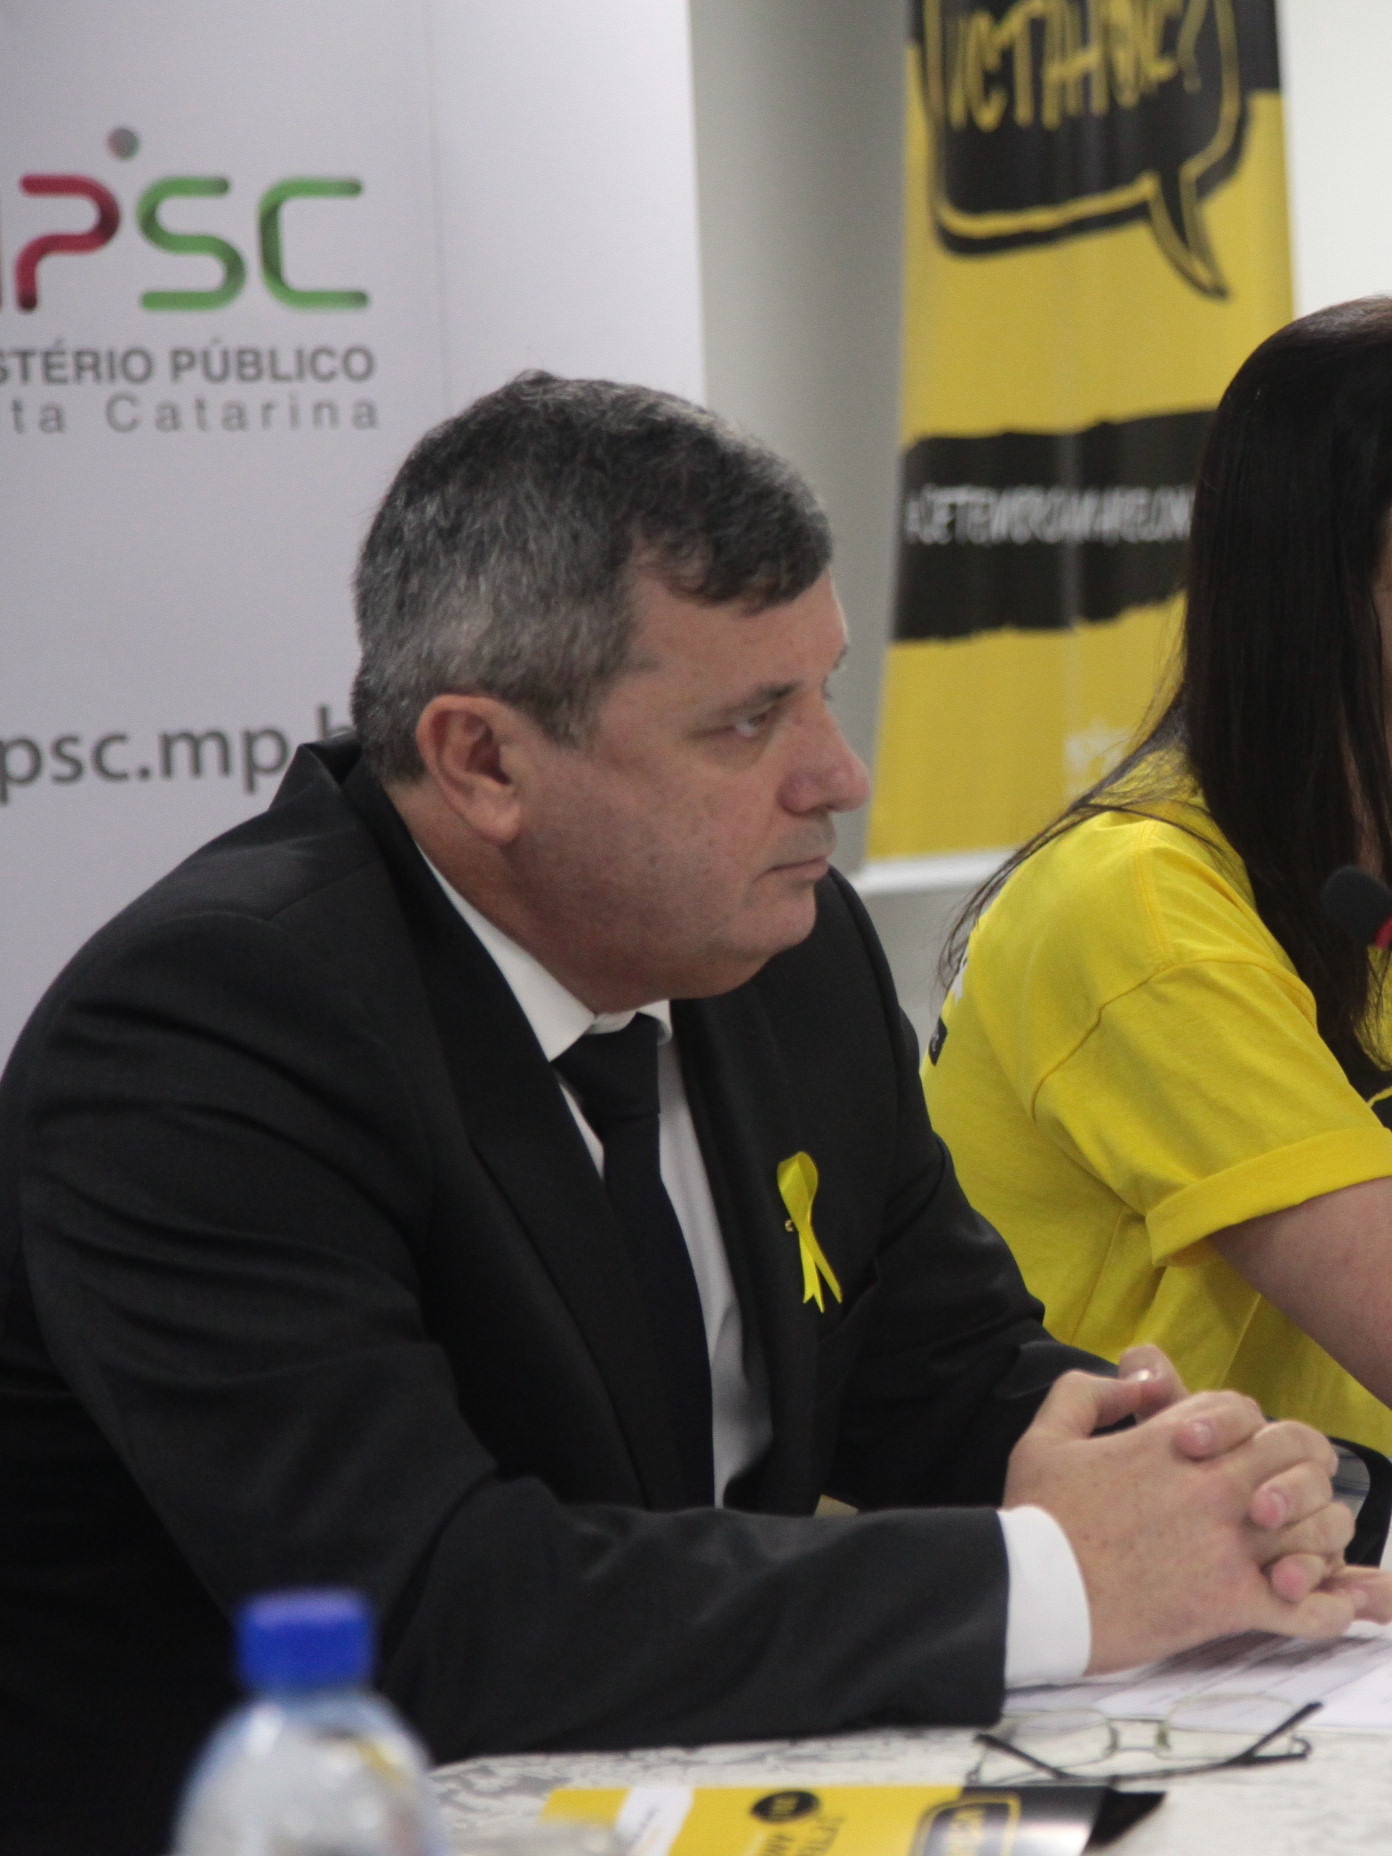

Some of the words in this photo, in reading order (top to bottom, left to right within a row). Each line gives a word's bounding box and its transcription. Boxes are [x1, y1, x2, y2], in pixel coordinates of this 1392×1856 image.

[0, 171, 369, 311] PSC
[169, 333, 375, 383] PÚBLICO
[105, 392, 379, 434] Catarina
